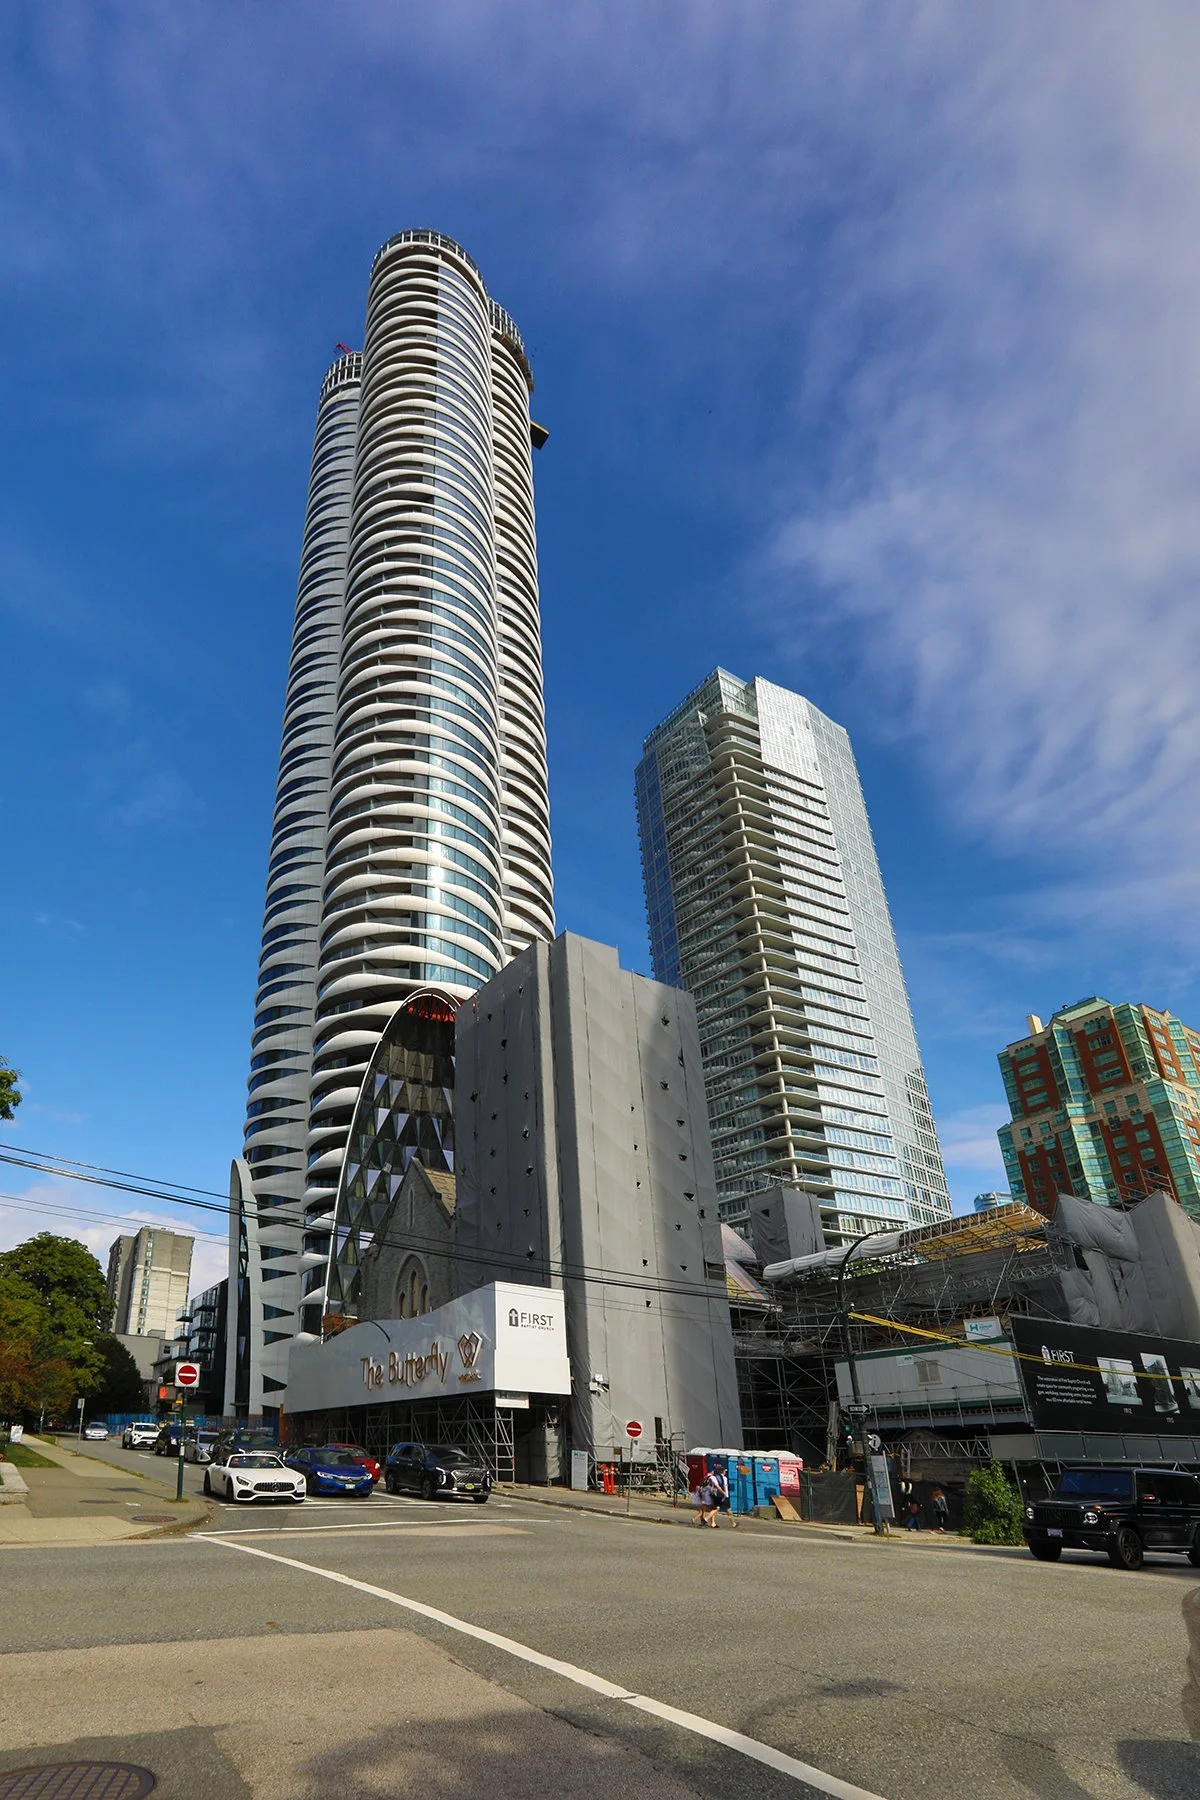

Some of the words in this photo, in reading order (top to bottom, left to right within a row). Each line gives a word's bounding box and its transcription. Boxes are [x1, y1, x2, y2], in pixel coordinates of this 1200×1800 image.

[521, 1312, 554, 1327] FIRST
[1050, 1349, 1075, 1363] FIRST
[360, 1356, 384, 1391] The
[388, 1341, 450, 1388] Butterfly
